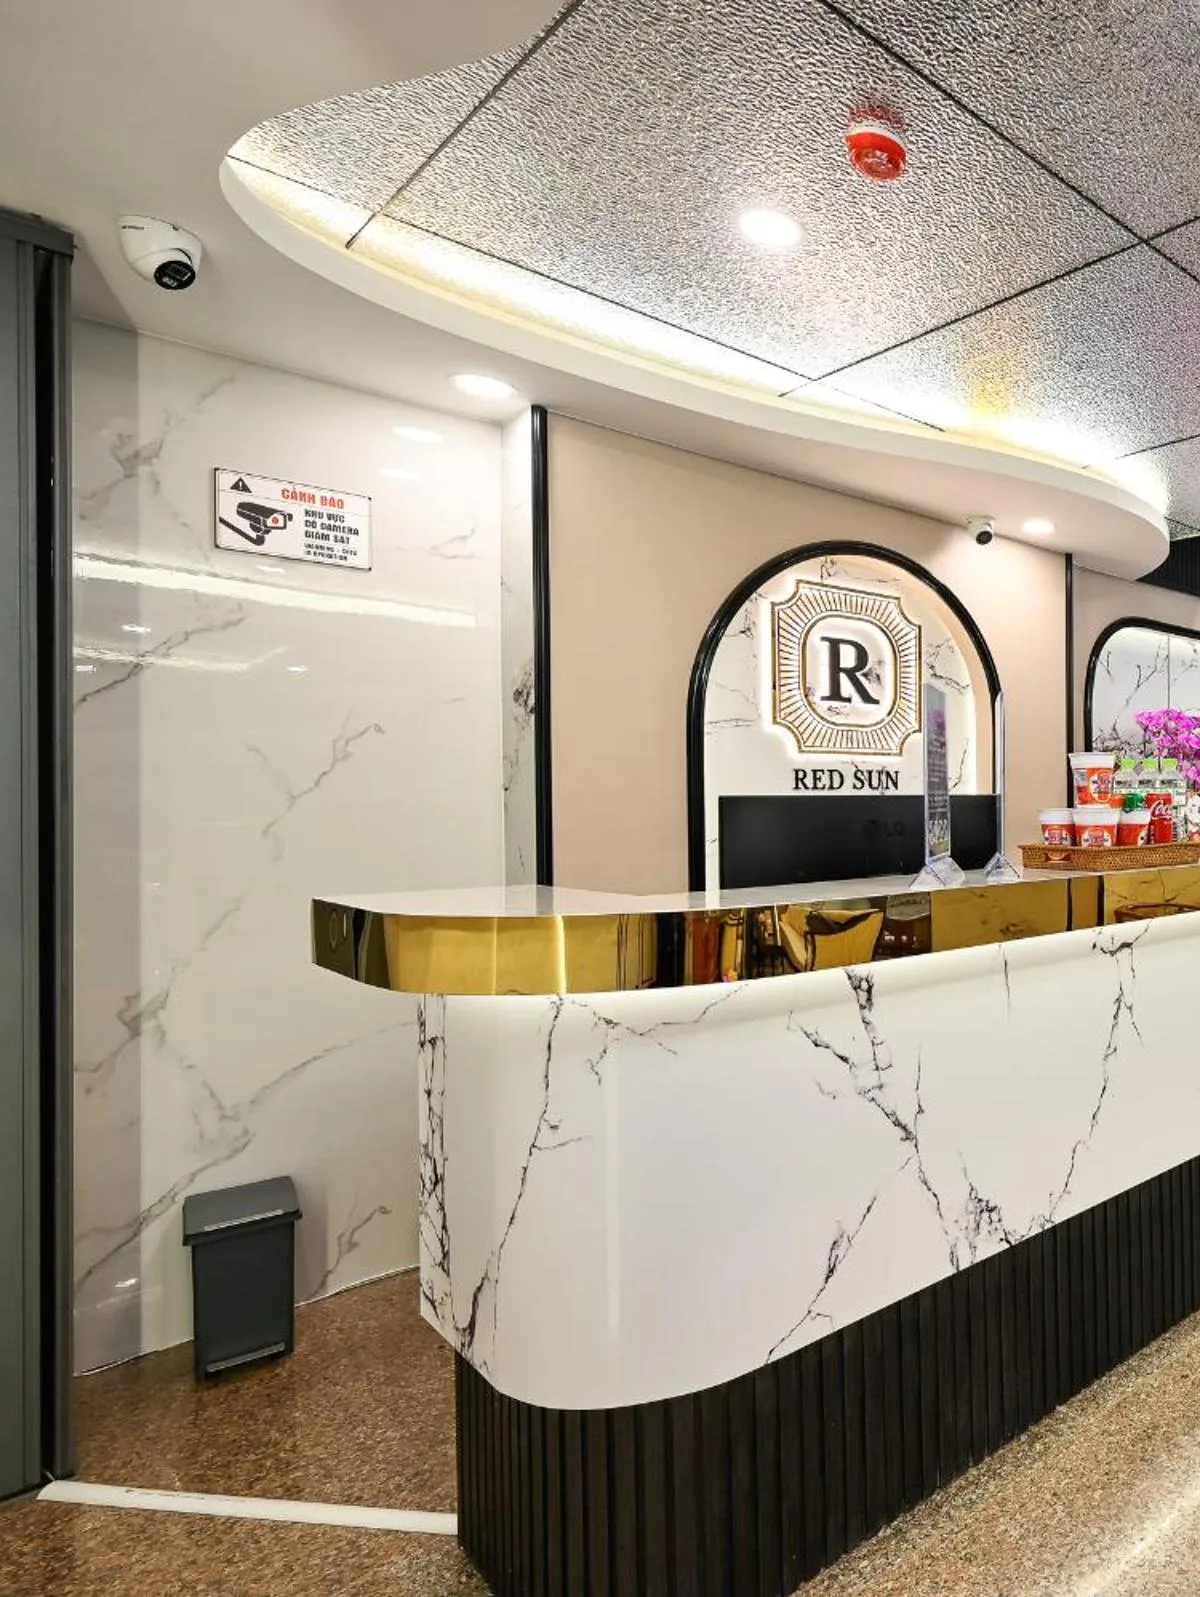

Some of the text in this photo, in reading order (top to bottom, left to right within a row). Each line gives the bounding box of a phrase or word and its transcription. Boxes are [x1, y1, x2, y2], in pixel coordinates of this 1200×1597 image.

[820, 636, 879, 705] R
[793, 768, 899, 790] RED SUN
